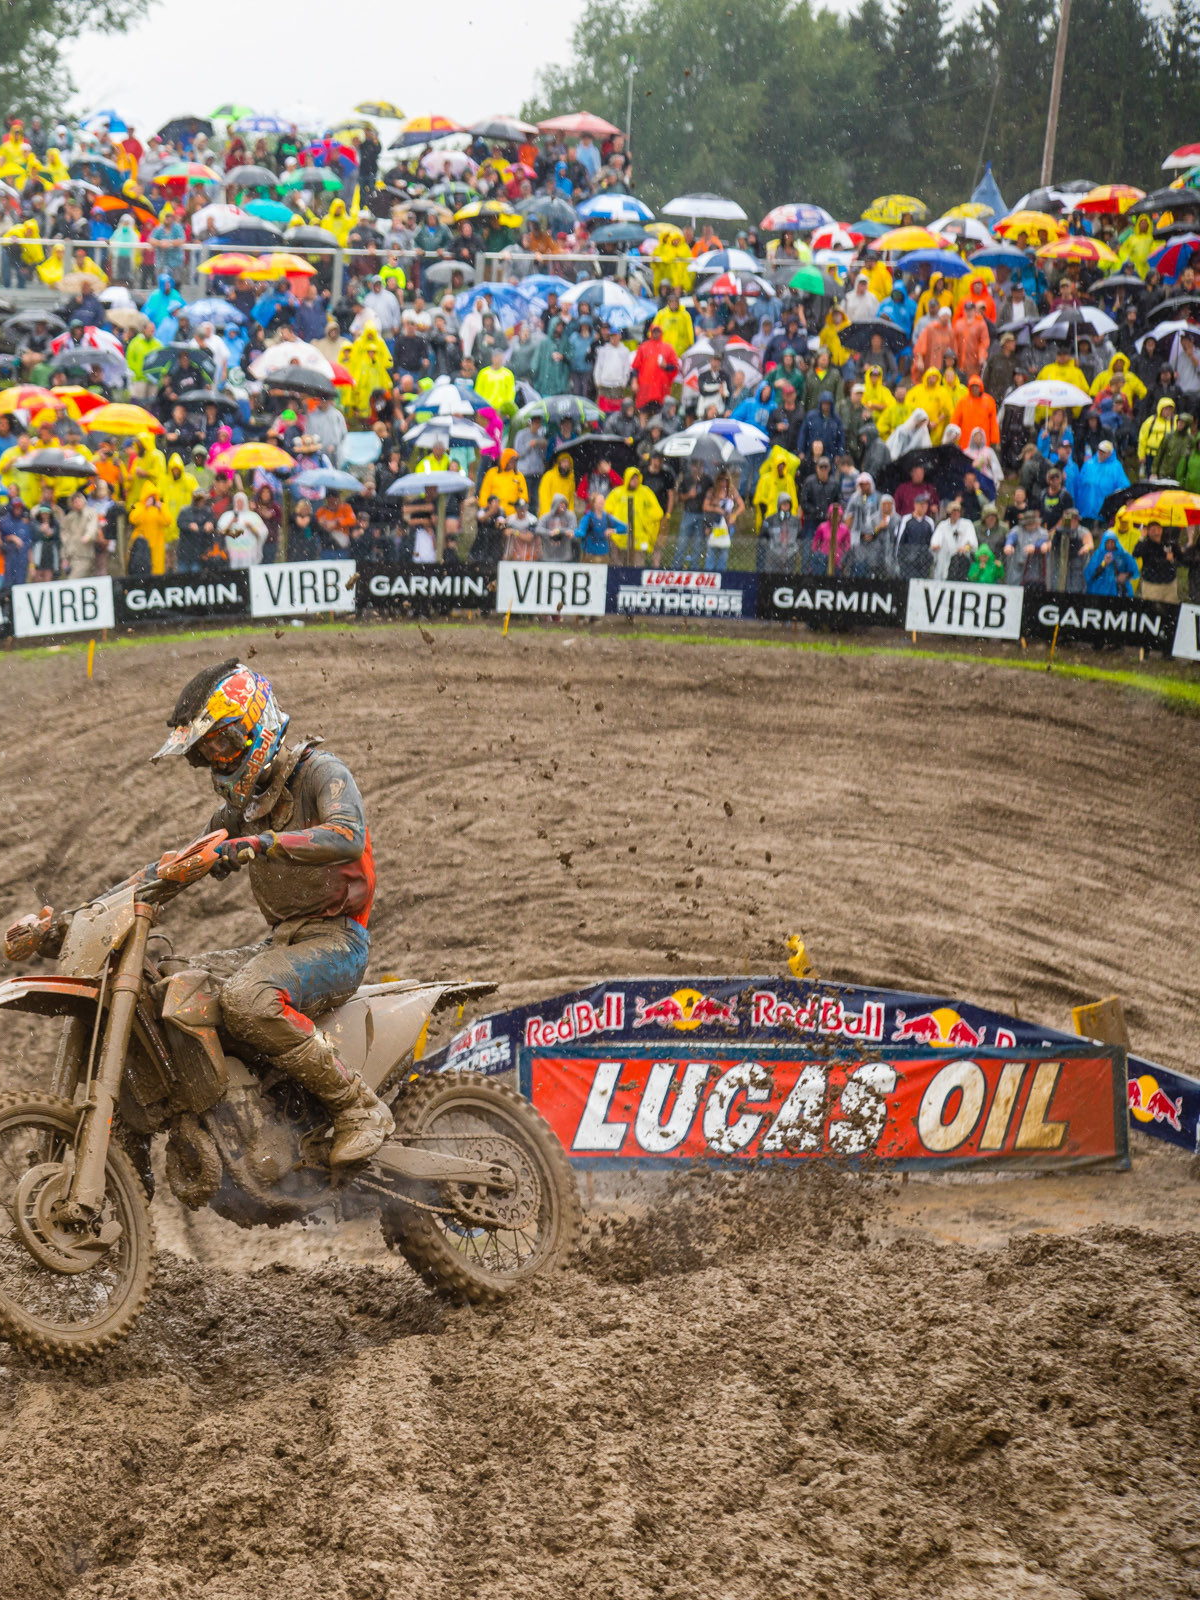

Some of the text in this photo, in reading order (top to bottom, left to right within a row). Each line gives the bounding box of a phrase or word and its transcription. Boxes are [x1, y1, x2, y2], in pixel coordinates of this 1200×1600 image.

[264, 568, 340, 606] VIRB
[370, 575, 485, 597] GARMIN
[513, 569, 591, 606] VIRB
[646, 571, 717, 587] LUCAS OIL
[27, 586, 98, 626] VIRB
[126, 583, 239, 611] GARMIN
[618, 591, 742, 611] MOTOCROSS
[773, 587, 893, 614] GARMIN
[924, 587, 1006, 628] VIRB
[1038, 605, 1161, 637] GARMIN
[241, 676, 271, 732] 100%
[570, 1060, 1070, 1155] LUCAS OIL
